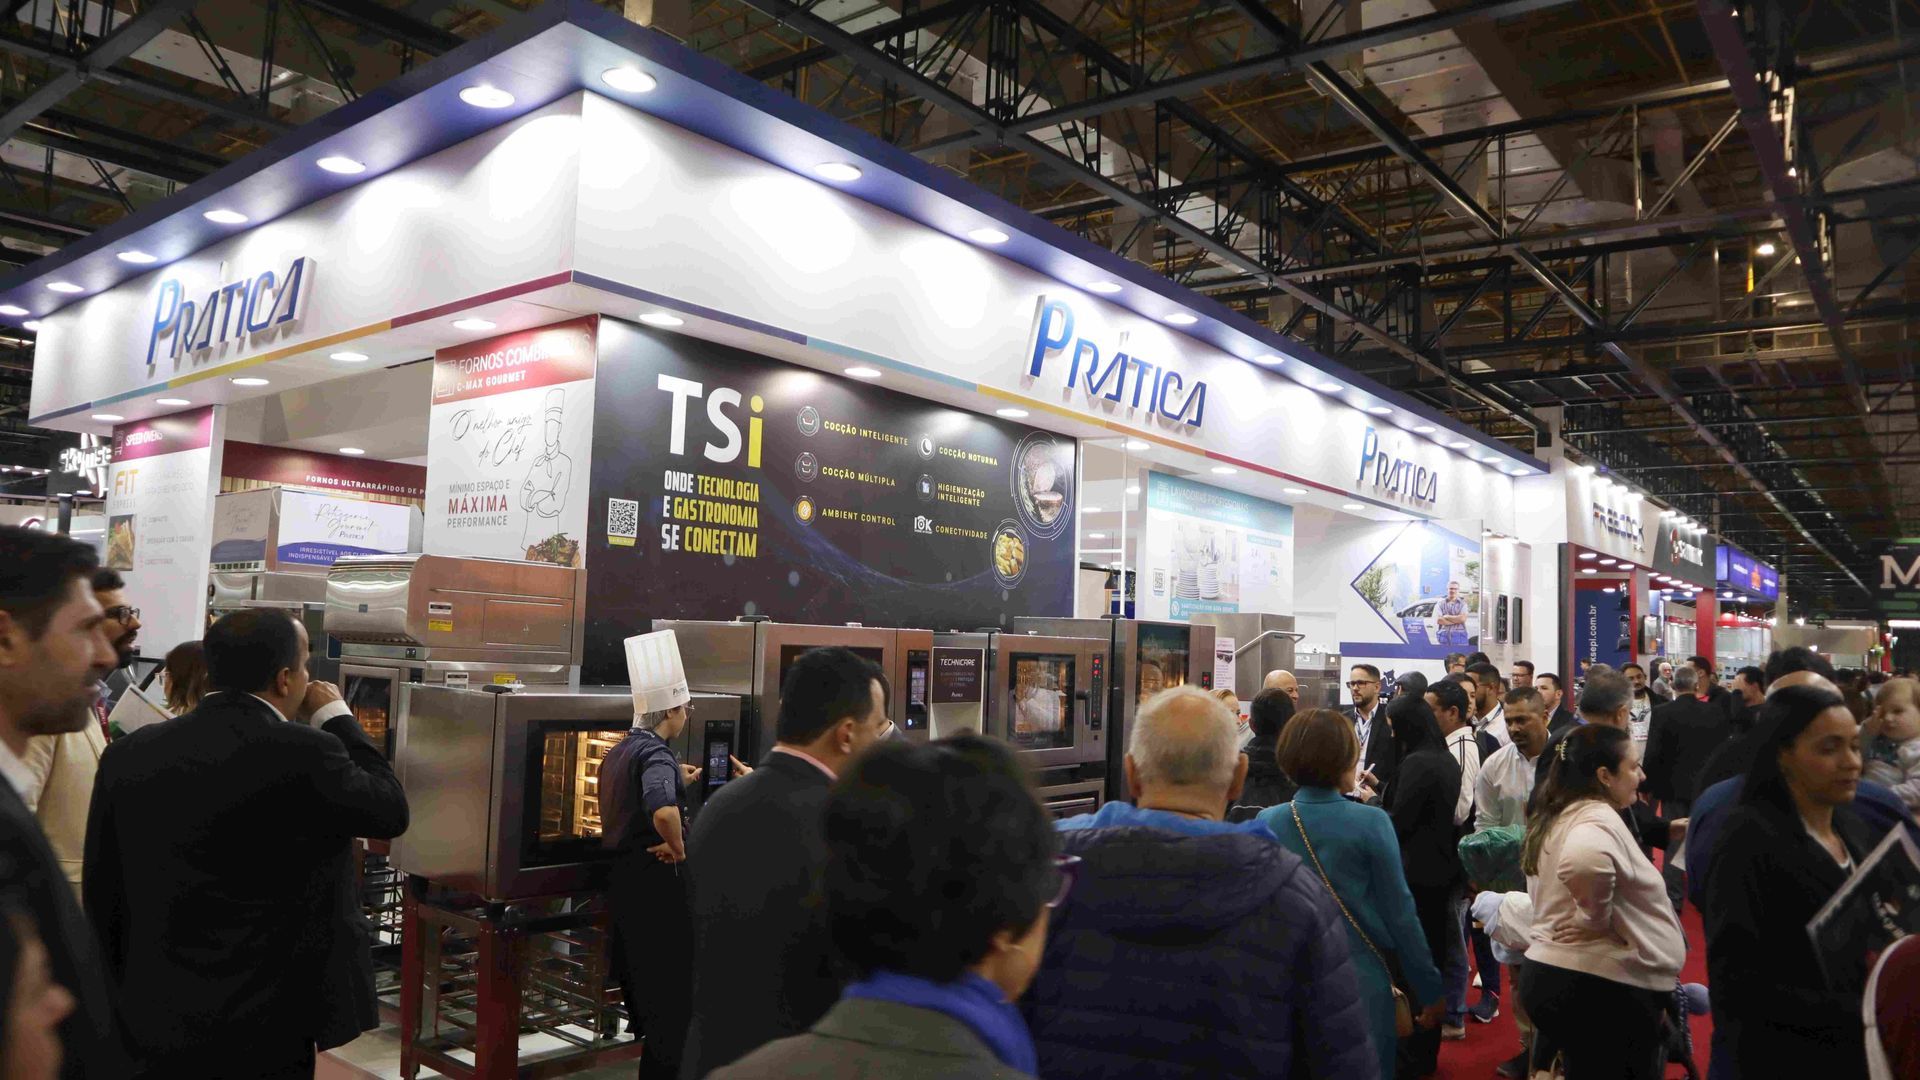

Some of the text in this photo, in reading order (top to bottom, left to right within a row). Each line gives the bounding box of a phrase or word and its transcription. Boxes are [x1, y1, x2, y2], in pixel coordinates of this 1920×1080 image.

[457, 351, 503, 375] FORNOS
[457, 370, 526, 392] C-MAX GOURMET
[450, 409, 475, 441] O
[658, 373, 764, 469] TSi
[824, 420, 909, 446] COCÇÃO INTELIGENTE
[492, 428, 527, 467] Chef
[938, 446, 998, 466] COCÇÃO NOTURNA
[114, 469, 138, 497] FIT
[305, 475, 339, 486] FORNOS
[341, 478, 405, 493] ULTRARRÁPIDOS
[408, 487, 417, 495] DE
[449, 479, 511, 495] MÍNIMO ESPAÇO E
[664, 470, 760, 503] ONDE TECNOLOGIA
[822, 466, 896, 487] COCÇÃO MÚLTIPLA
[937, 483, 985, 499] HIGIENIZAÇÃO
[937, 493, 981, 507] INTELIGENTE
[448, 491, 508, 515] MÁXIMA
[663, 495, 759, 529] E GASTRONOMIA
[447, 515, 508, 529] PERFORMANCE
[822, 508, 896, 526] AMBIENT CONTROL
[661, 523, 758, 558] SE CONECTAM
[935, 525, 988, 539] CONECTIVIDADE
[940, 658, 976, 667] TECHNICARE
